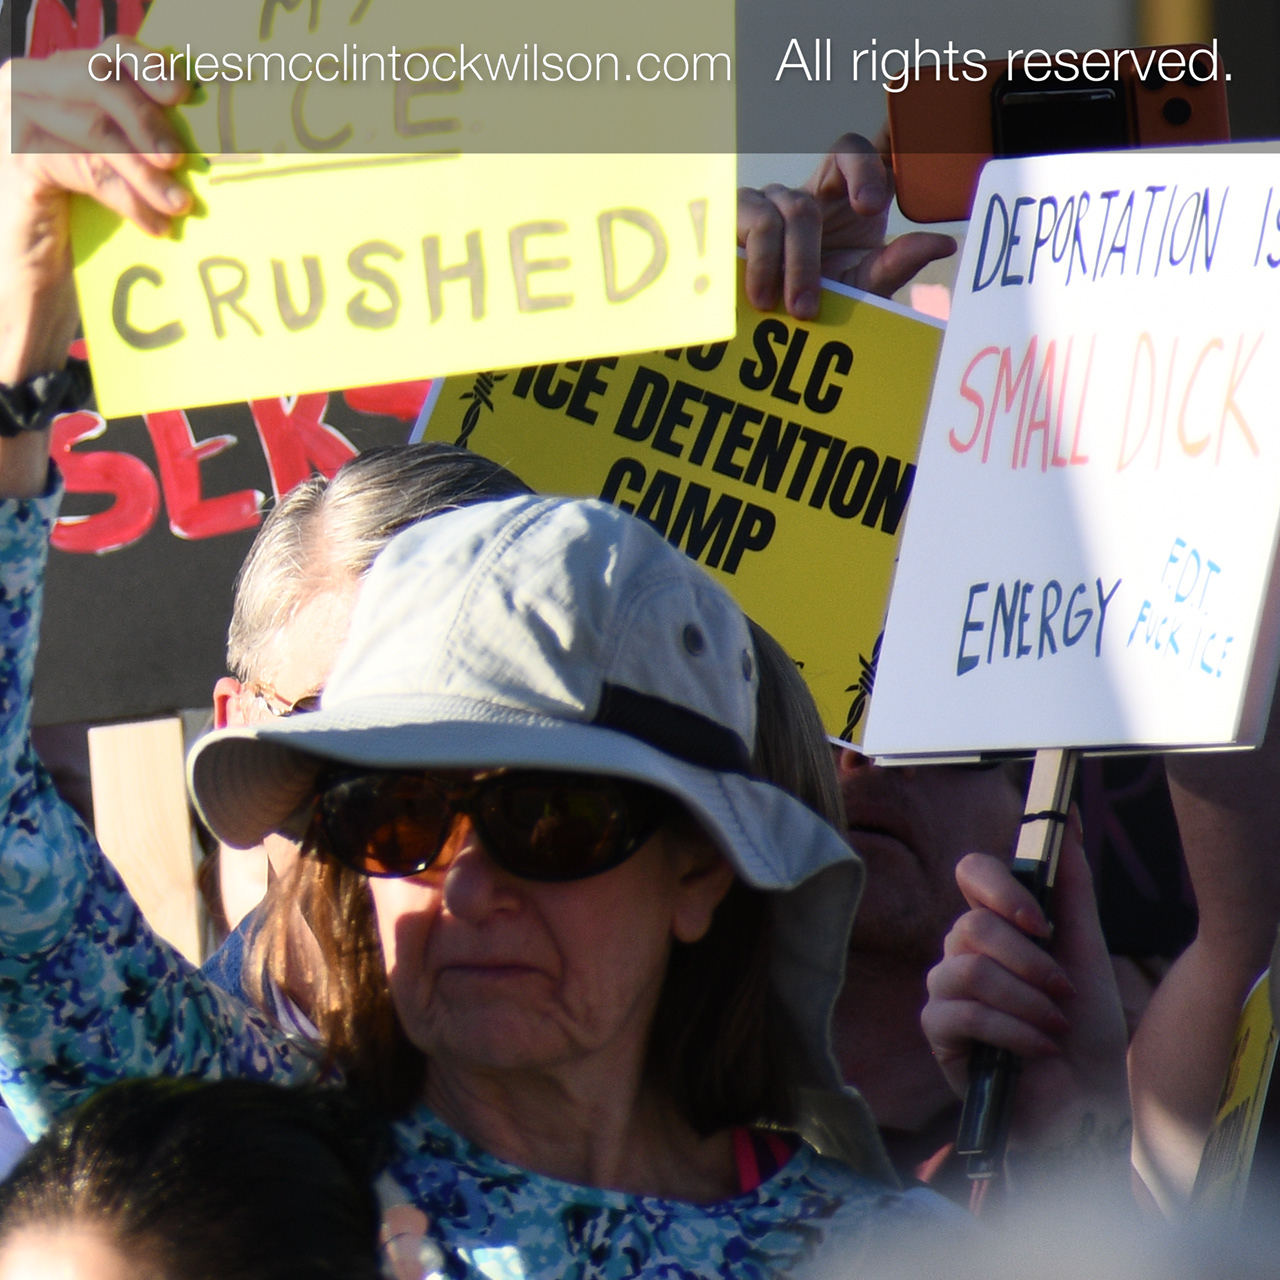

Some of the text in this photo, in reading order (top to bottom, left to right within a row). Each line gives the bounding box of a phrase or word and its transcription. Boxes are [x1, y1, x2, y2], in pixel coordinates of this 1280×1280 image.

[111, 199, 711, 350] CRUSHED!
[972, 184, 1230, 287] DEPORTATION
[739, 318, 854, 415] SLC
[949, 331, 1264, 473] SMALL DICK
[613, 365, 918, 536] DETENTION
[598, 456, 776, 576] CAMP
[956, 577, 1122, 676] ENERGY
[1126, 599, 1183, 659] FUCK
